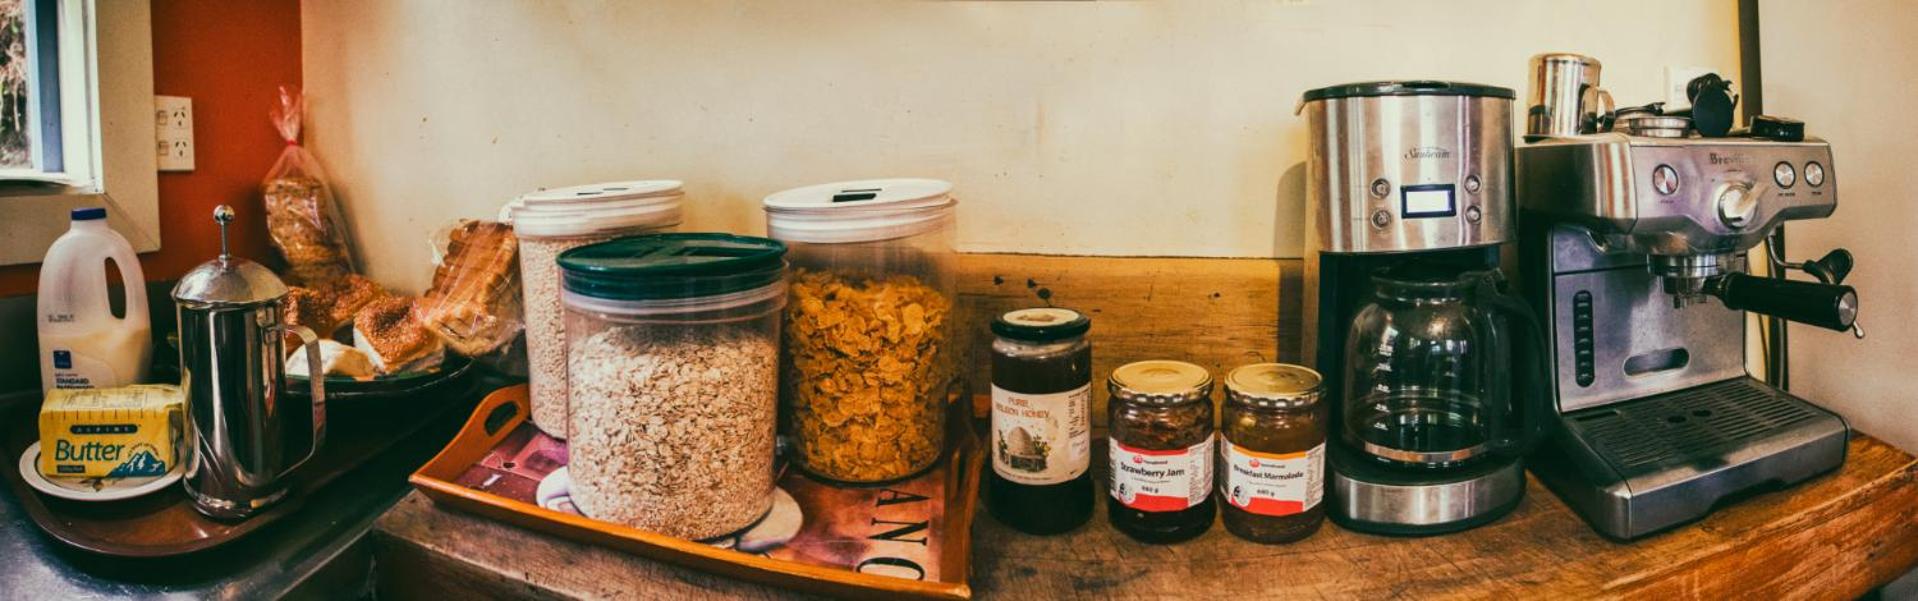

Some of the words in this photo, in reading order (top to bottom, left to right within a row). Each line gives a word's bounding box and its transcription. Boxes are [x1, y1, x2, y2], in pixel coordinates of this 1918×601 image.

[55, 439, 125, 461] Butter
[1121, 462, 1165, 479] Strawberry
[1166, 468, 1185, 477] Jam
